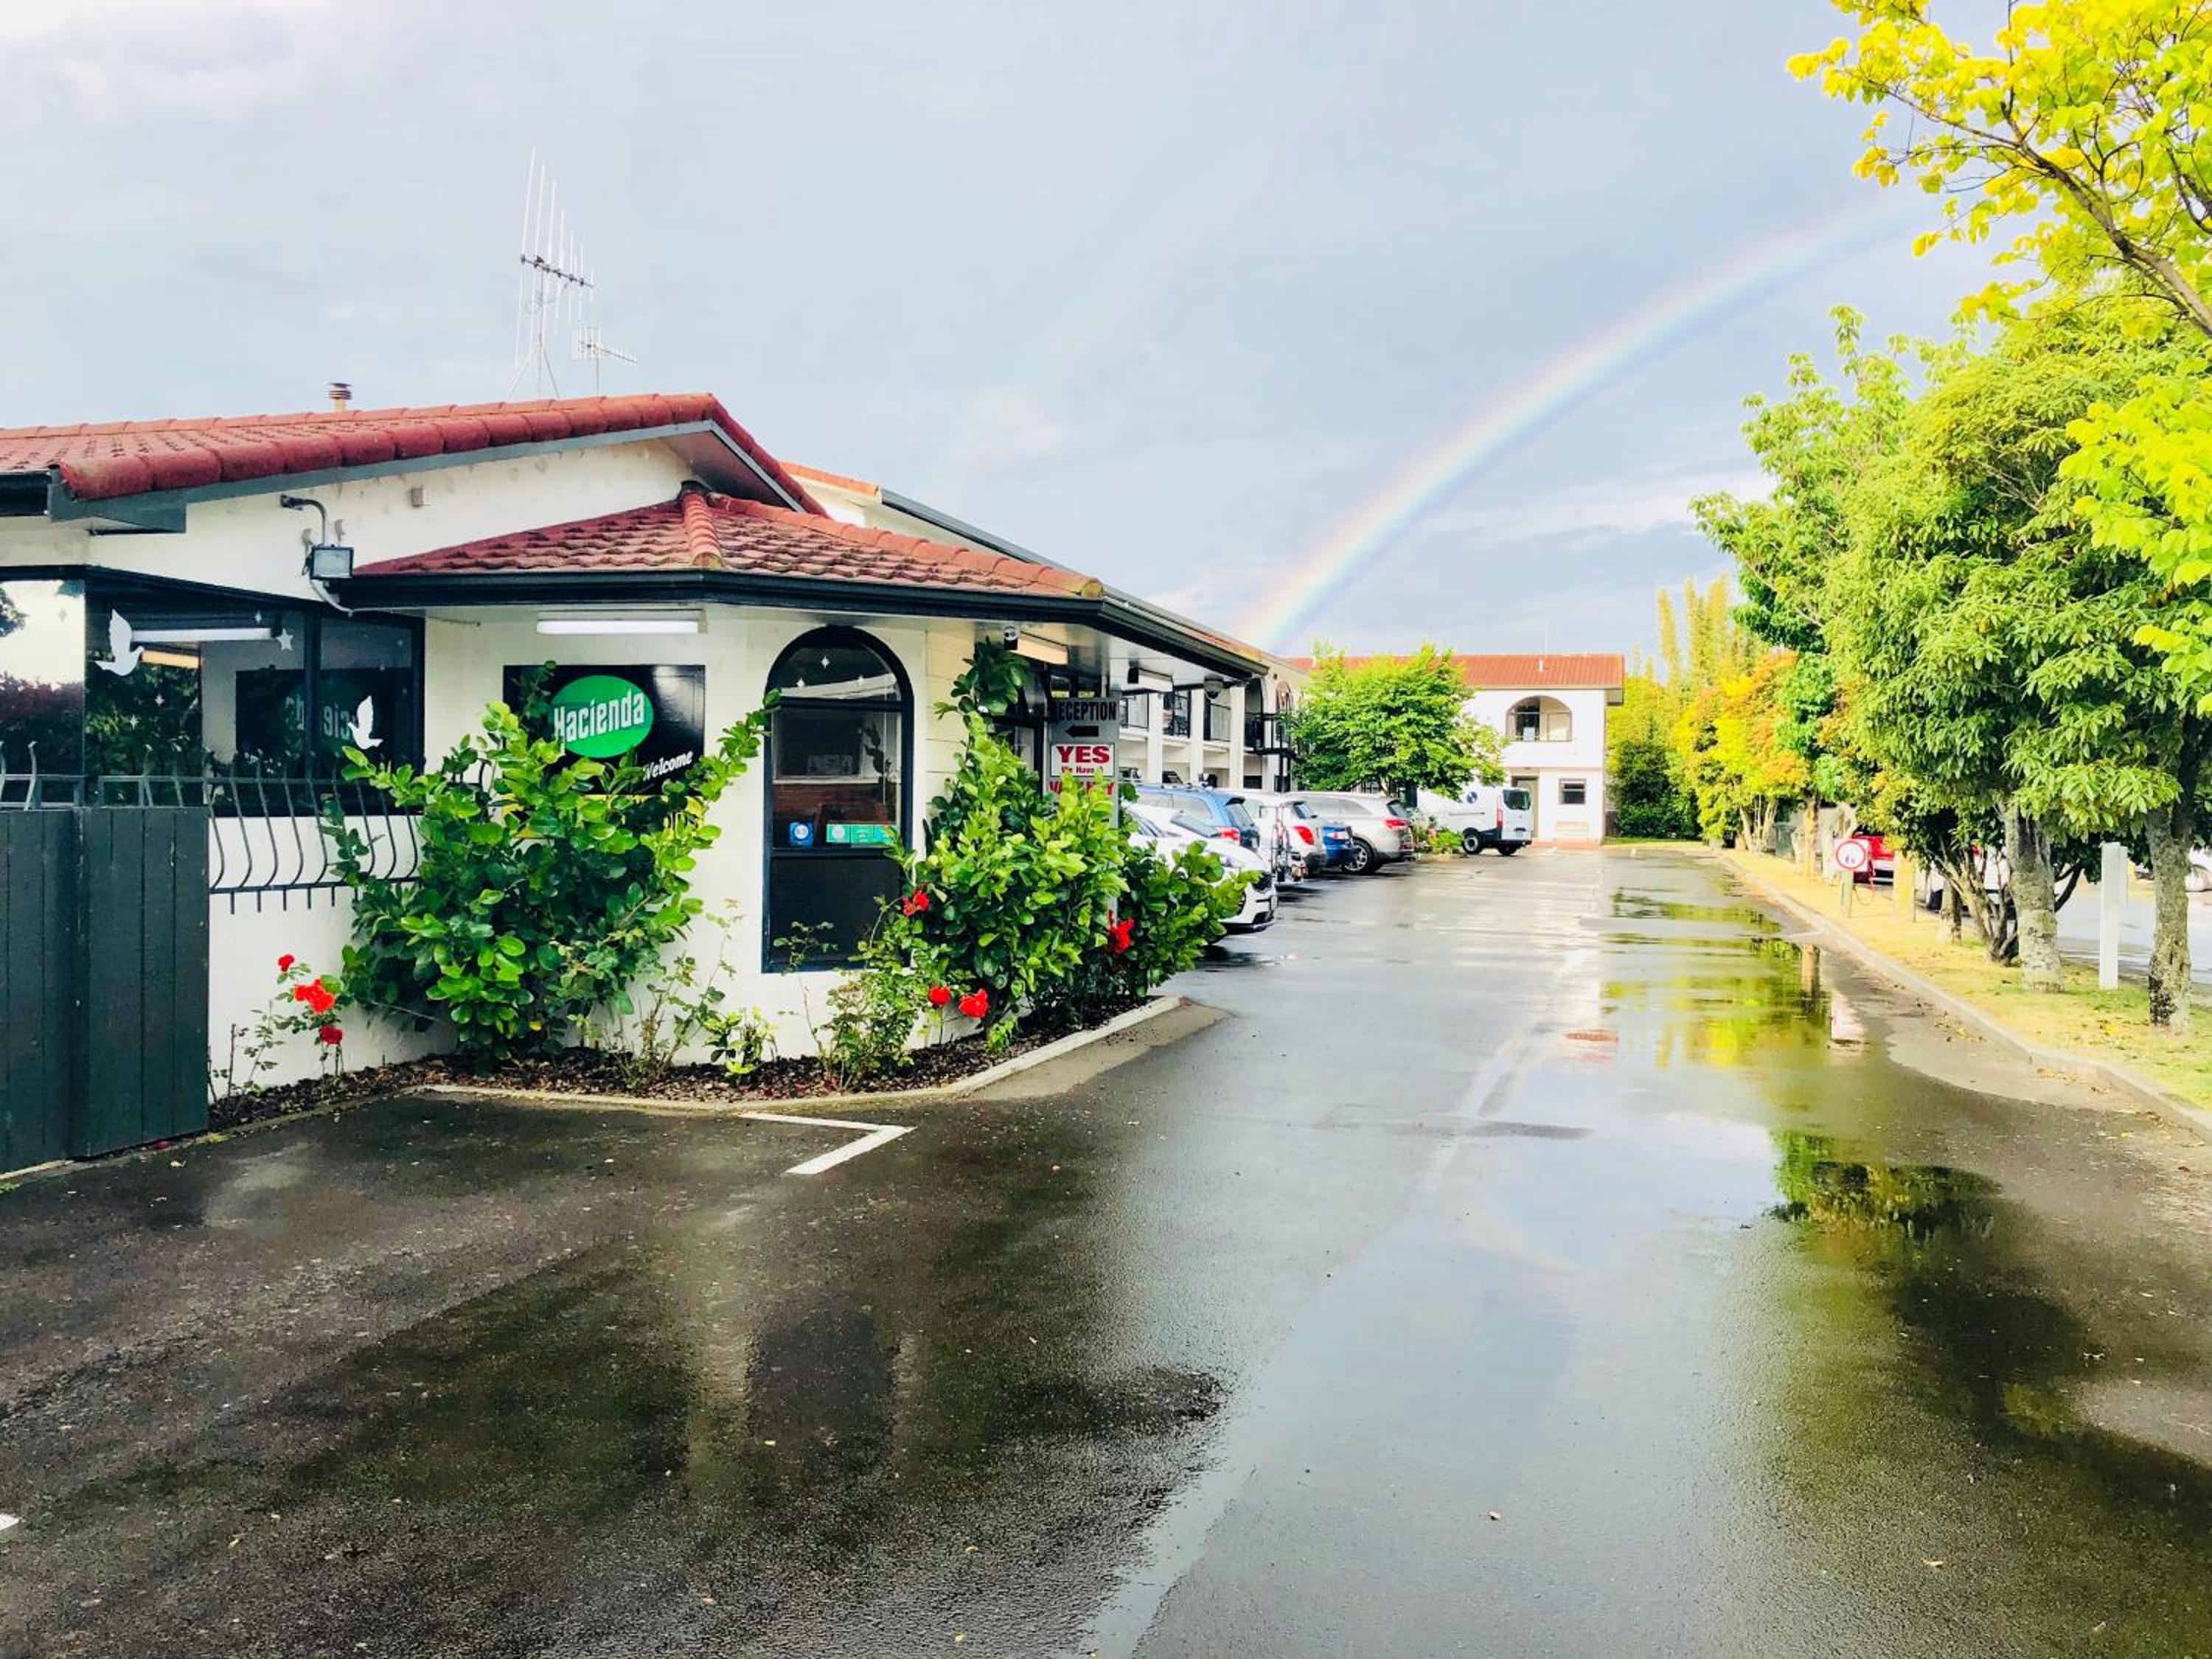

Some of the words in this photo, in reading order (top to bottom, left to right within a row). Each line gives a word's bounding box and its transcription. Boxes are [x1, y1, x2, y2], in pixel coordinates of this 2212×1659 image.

[554, 686, 645, 748] Hacienda
[1051, 701, 1117, 720] ECEPTION
[642, 751, 694, 782] Welcome
[1056, 745, 1110, 764] YES
